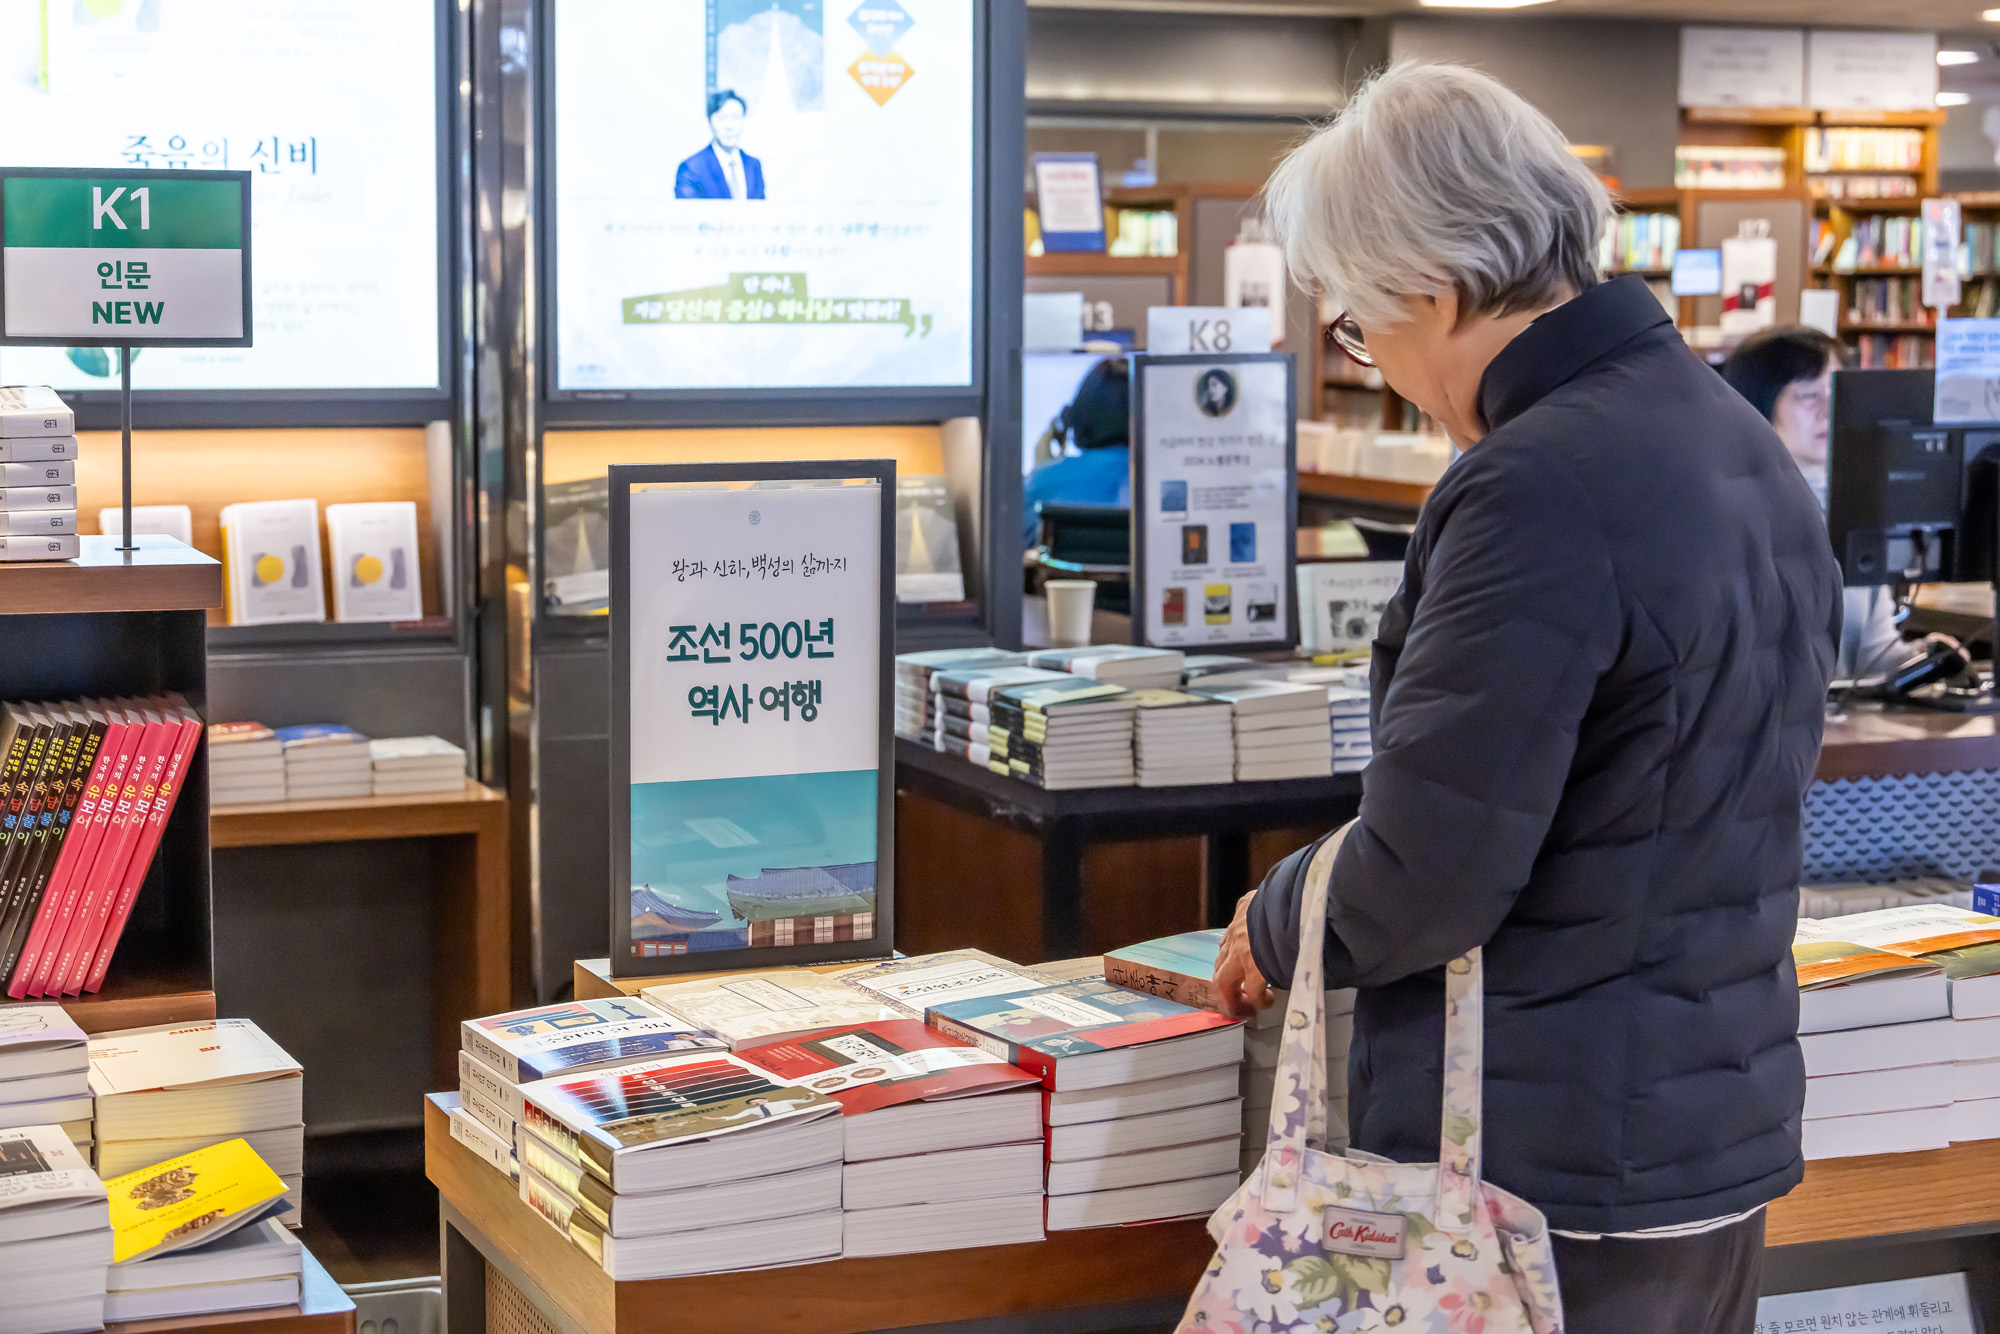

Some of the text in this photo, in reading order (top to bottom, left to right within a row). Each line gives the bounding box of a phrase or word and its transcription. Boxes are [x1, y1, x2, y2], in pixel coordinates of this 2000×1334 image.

[249, 135, 319, 176] 신비
[92, 186, 151, 230] K1
[96, 260, 151, 290] 인문
[91, 301, 165, 325] NEW
[1188, 320, 1233, 353] K8
[671, 558, 708, 583] 왕과
[800, 551, 849, 579] 삶까지
[665, 617, 836, 665] 조선 500년
[687, 678, 824, 726] 역사 여행
[17, 780, 48, 846] 속담풀이
[34, 778, 65, 844] 속담풀이
[52, 776, 84, 842] 속담풀이
[76, 755, 111, 830] 한국의 유모어
[94, 754, 128, 828] 한국의 유모어
[112, 755, 147, 830] 한국의 유모어
[131, 755, 165, 829] 한국의 유모어
[149, 754, 182, 827] 한국의 유모어
[1329, 1221, 1354, 1240] Cath
[1784, 1319, 1818, 1333] 모르면
[1820, 1314, 1844, 1329] 원치
[1845, 1311, 1869, 1328] 않는
[1871, 1307, 1906, 1324] 관계에
[1907, 1300, 1954, 1318] 휘둘리고
